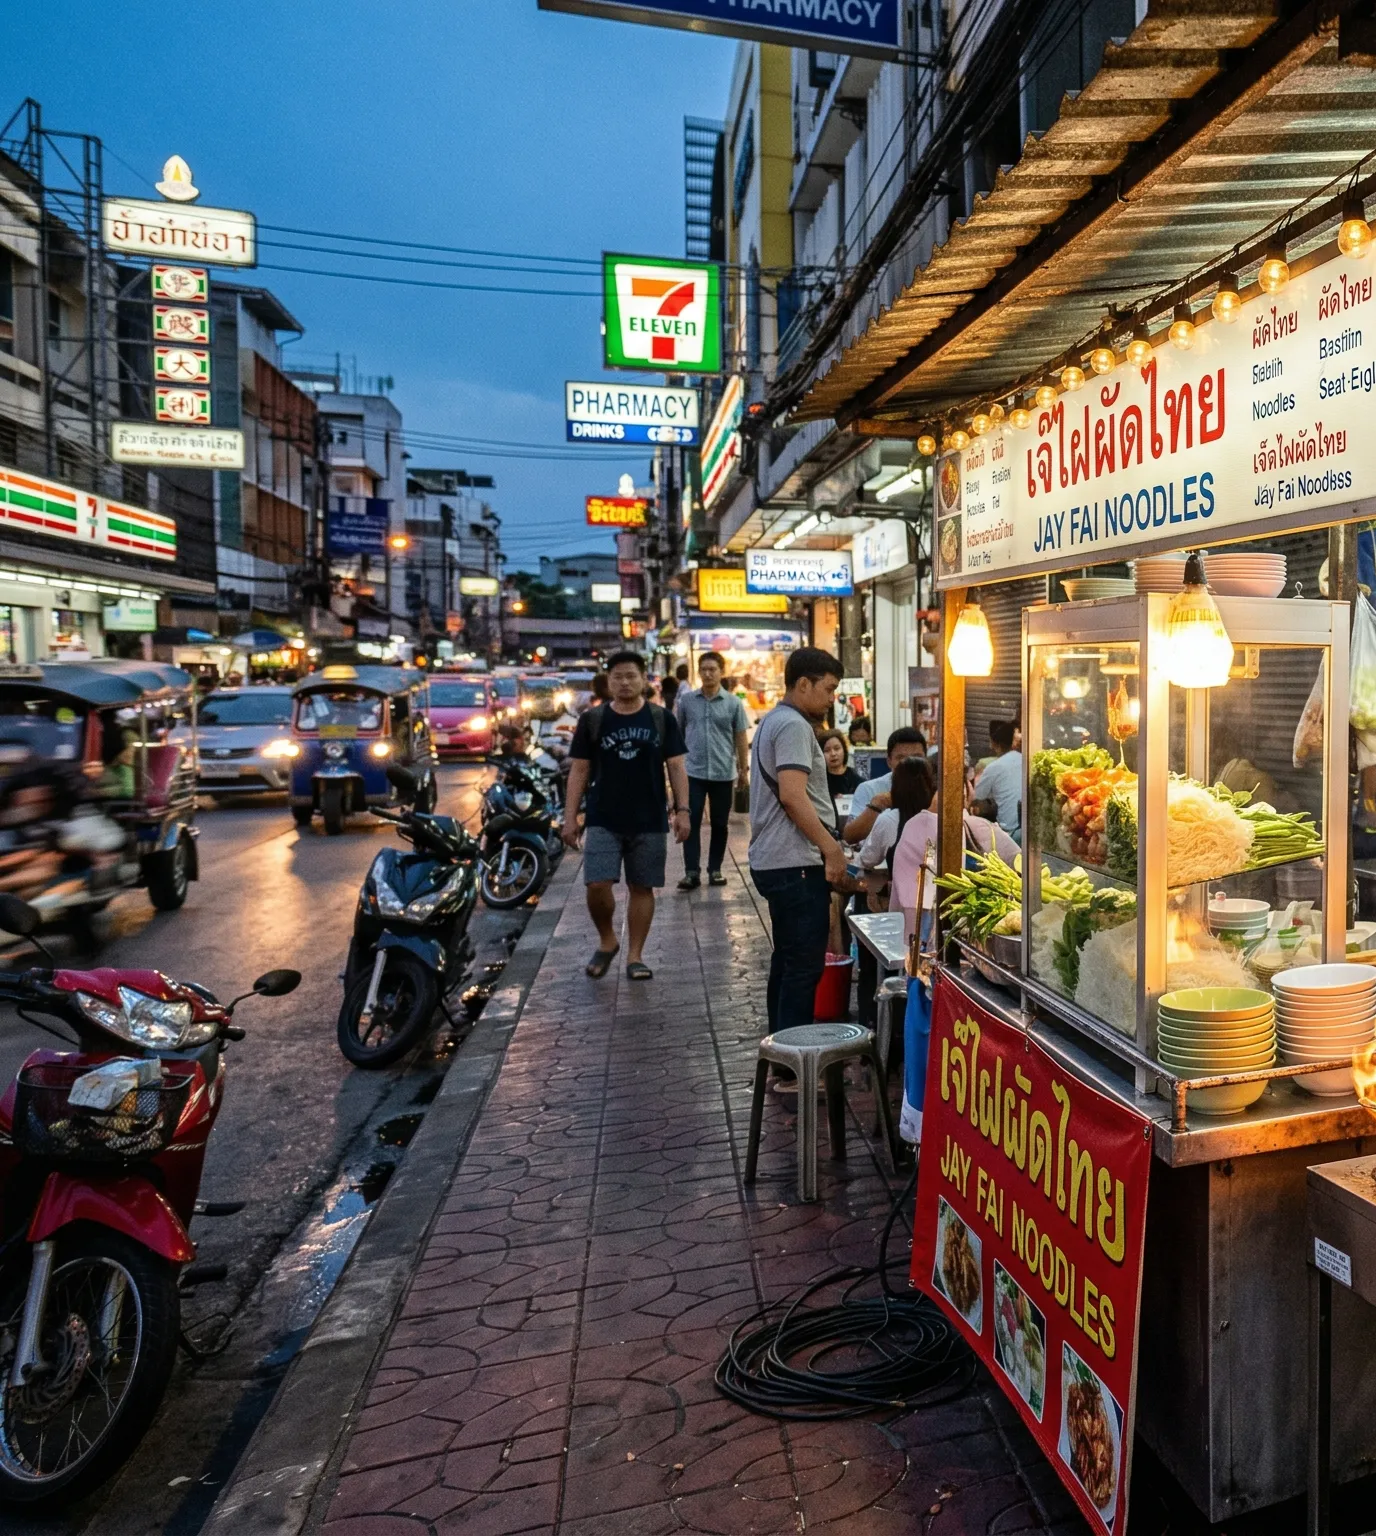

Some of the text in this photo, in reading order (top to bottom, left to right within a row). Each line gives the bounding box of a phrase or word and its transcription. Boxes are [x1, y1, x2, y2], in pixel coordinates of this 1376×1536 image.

[1318, 273, 1373, 321] ผัดไทย
[572, 390, 691, 419] PHARMACY
[1252, 392, 1296, 421] Noodles
[572, 422, 625, 439] DRINKS
[1278, 478, 1295, 502] Fai
[1034, 511, 1065, 552] JAY
[1071, 502, 1098, 545] FAI
[1105, 472, 1215, 538] NOODLES
[940, 1135, 1116, 1359] JAY FAI NOODLES
